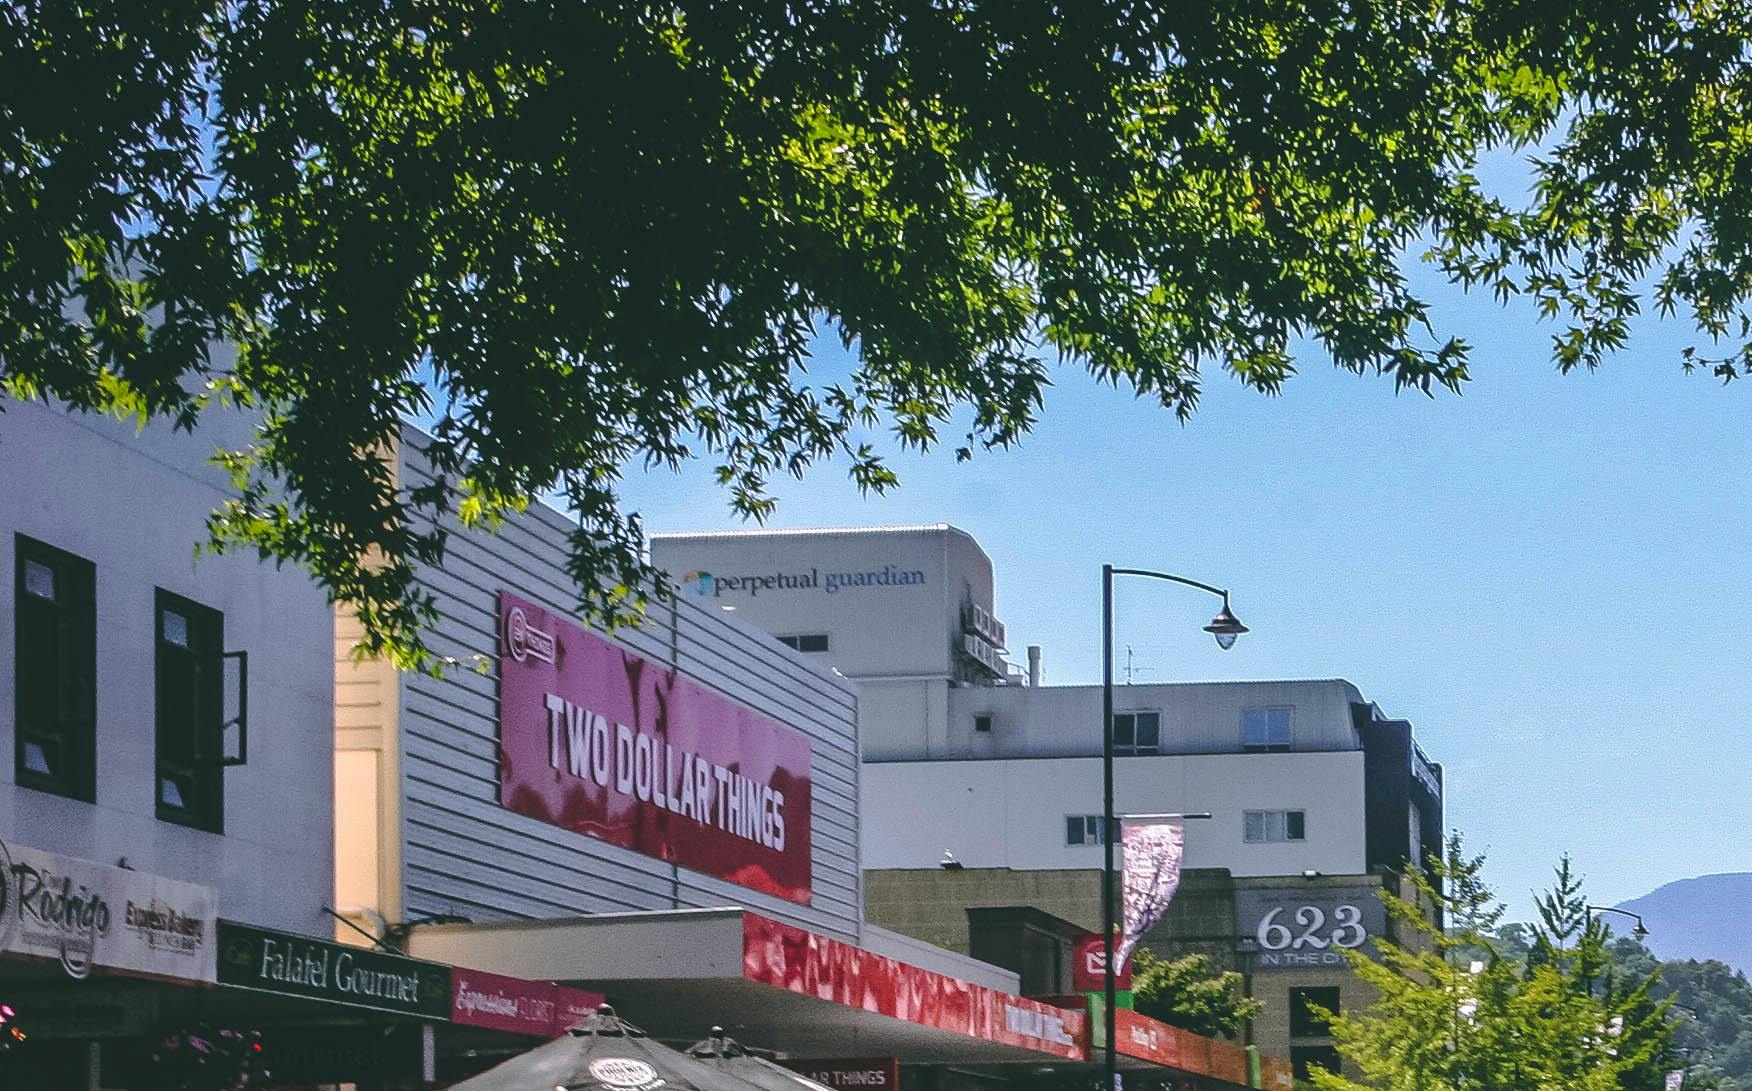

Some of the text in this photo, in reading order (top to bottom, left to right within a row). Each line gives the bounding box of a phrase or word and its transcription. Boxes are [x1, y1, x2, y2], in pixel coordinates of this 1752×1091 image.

[714, 568, 926, 597] perpetual guardian
[545, 692, 786, 854] TWO DOLLAR THINGS
[1257, 904, 1367, 950] 623
[260, 938, 420, 1003] Falafel Gourmet
[1283, 952, 1319, 964] THE
[832, 1070, 885, 1085] THINGS
